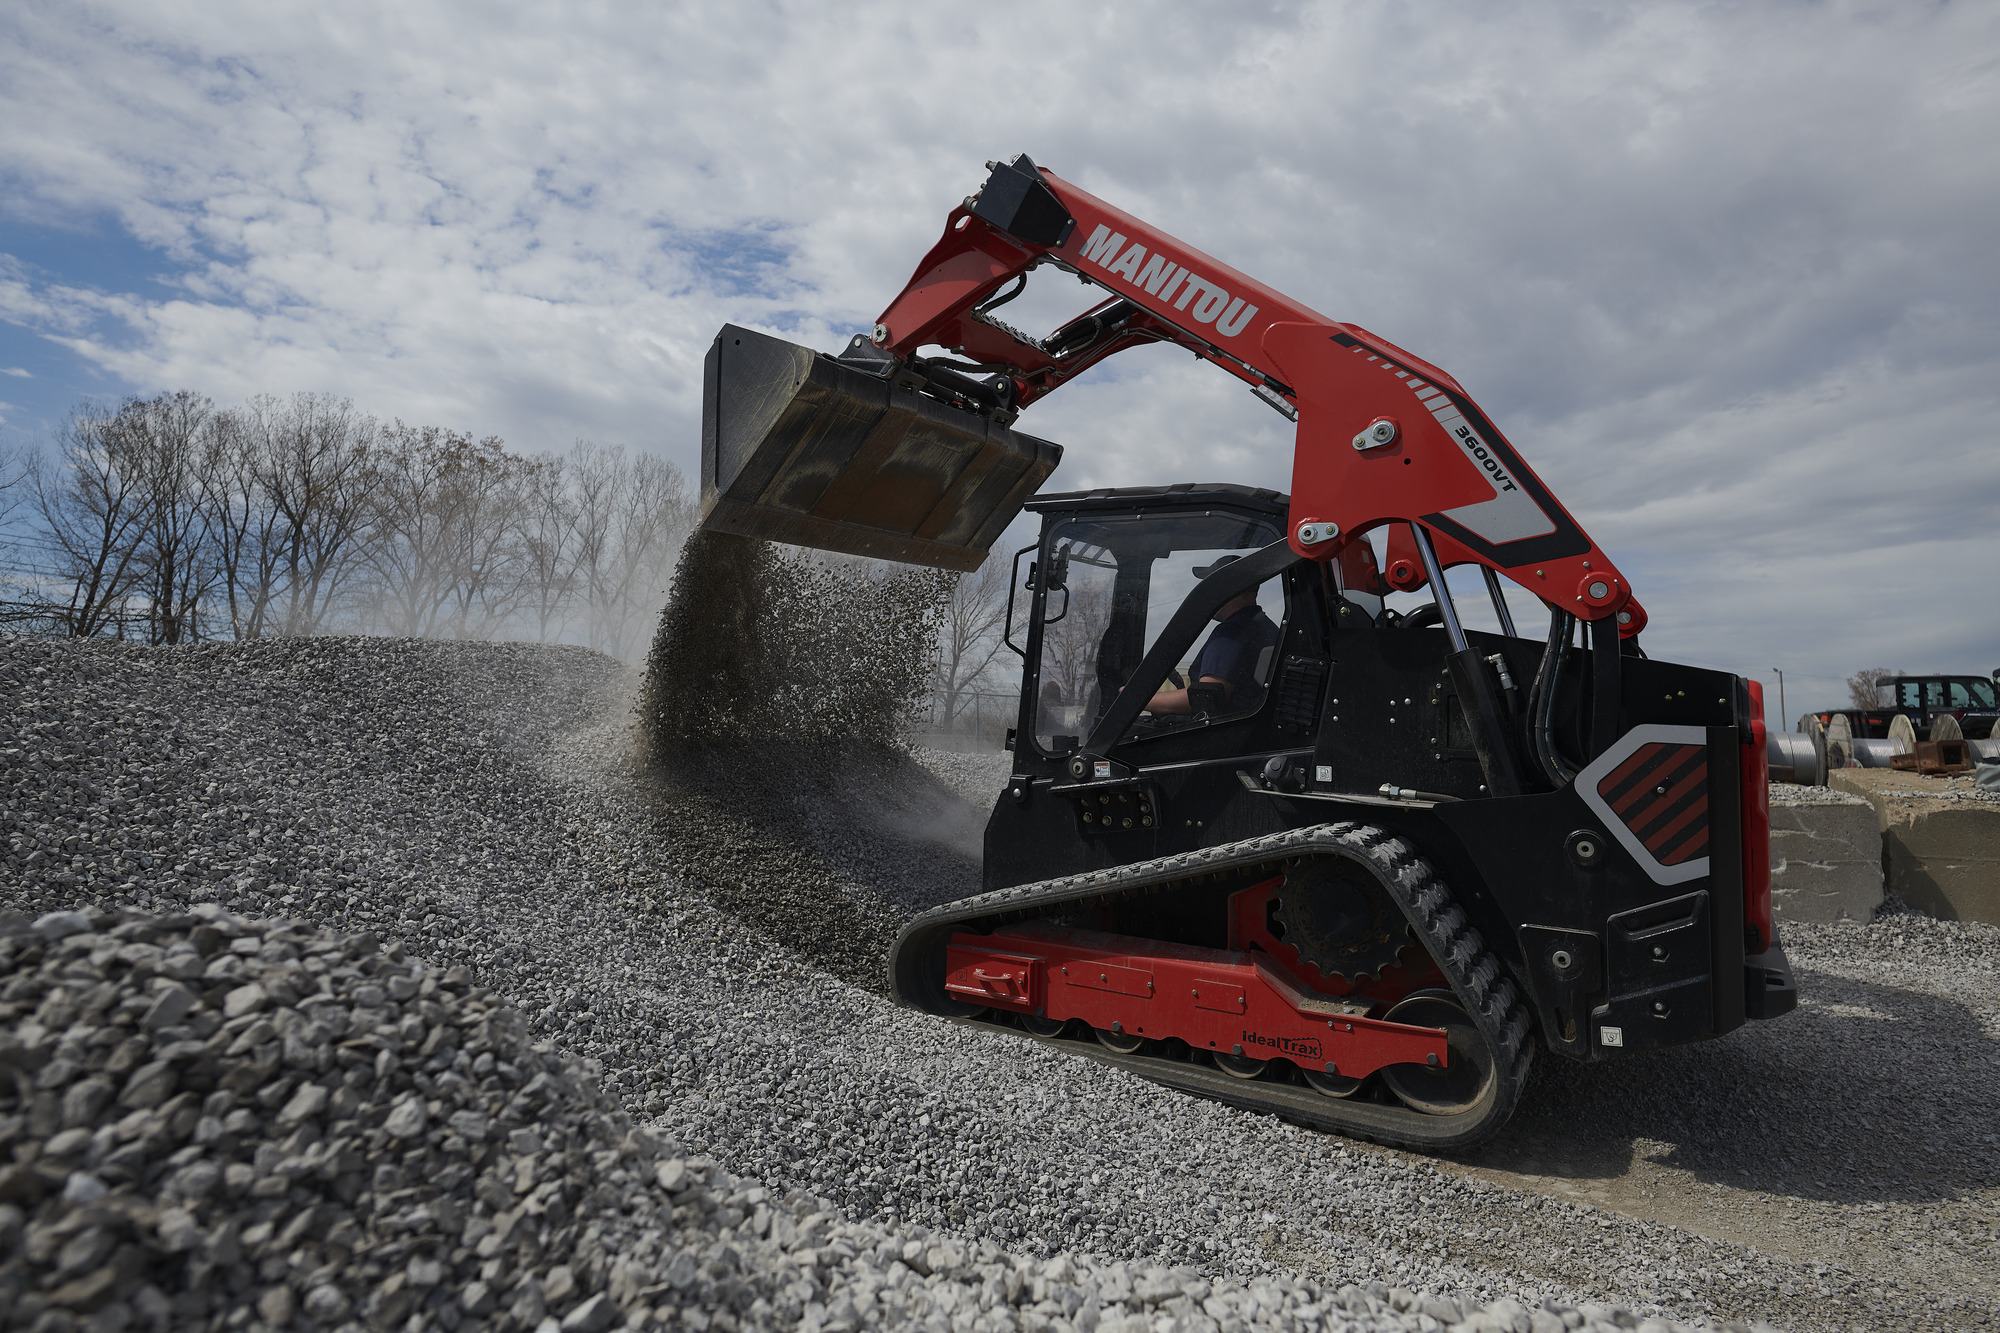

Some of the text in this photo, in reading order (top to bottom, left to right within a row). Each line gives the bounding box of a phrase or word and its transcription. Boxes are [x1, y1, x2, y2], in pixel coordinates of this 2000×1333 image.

[1078, 223, 1260, 338] MANITOU
[1454, 425, 1518, 492] 3600VT
[1242, 1030, 1319, 1056] IdealTrax
